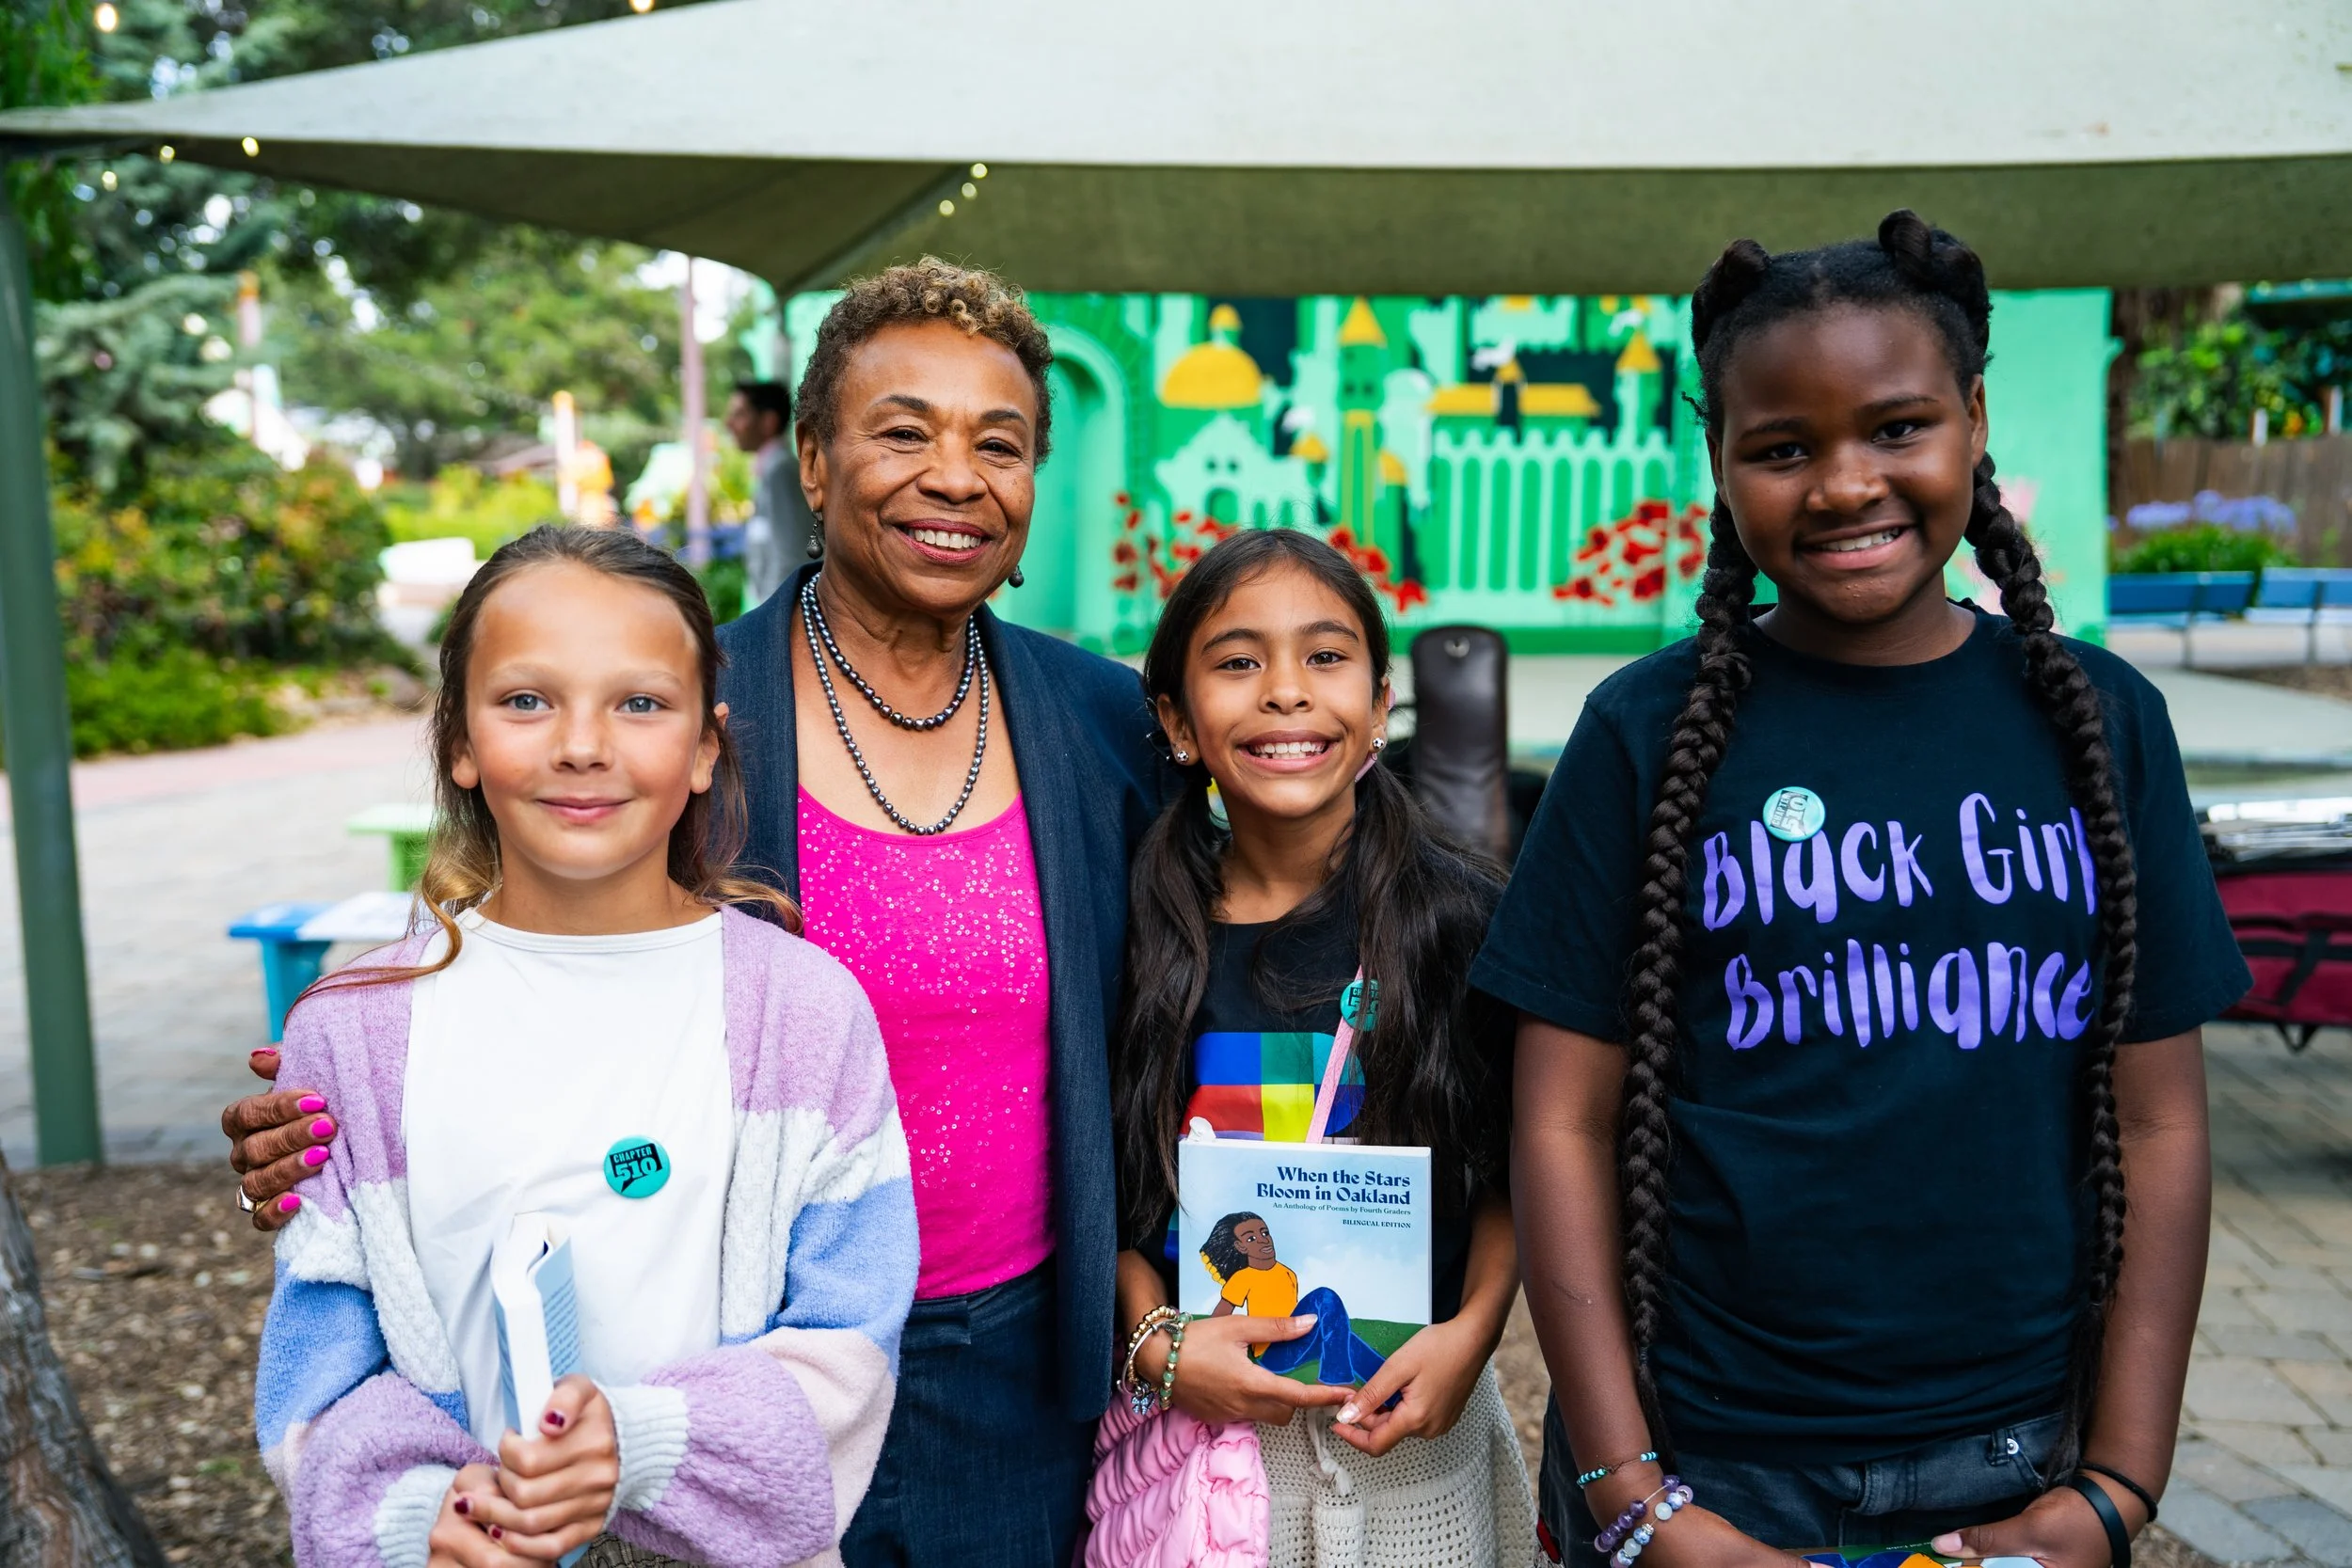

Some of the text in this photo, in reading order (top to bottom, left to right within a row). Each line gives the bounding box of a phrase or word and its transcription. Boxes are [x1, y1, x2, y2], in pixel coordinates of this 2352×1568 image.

[1772, 793, 1790, 825] CHAPTER
[1781, 797, 1805, 833] 510
[1703, 792, 2096, 931] Black Girl
[1724, 939, 2095, 1050] Brilliance
[612, 1146, 653, 1164] CHAPTER
[614, 1156, 658, 1182] 510
[1277, 1165, 1411, 1188] When the Stars
[1256, 1182, 1410, 1205] Bloom in Oakland
[1283, 1202, 1317, 1212] Anthology
[1359, 1206, 1383, 1214] Fourth
